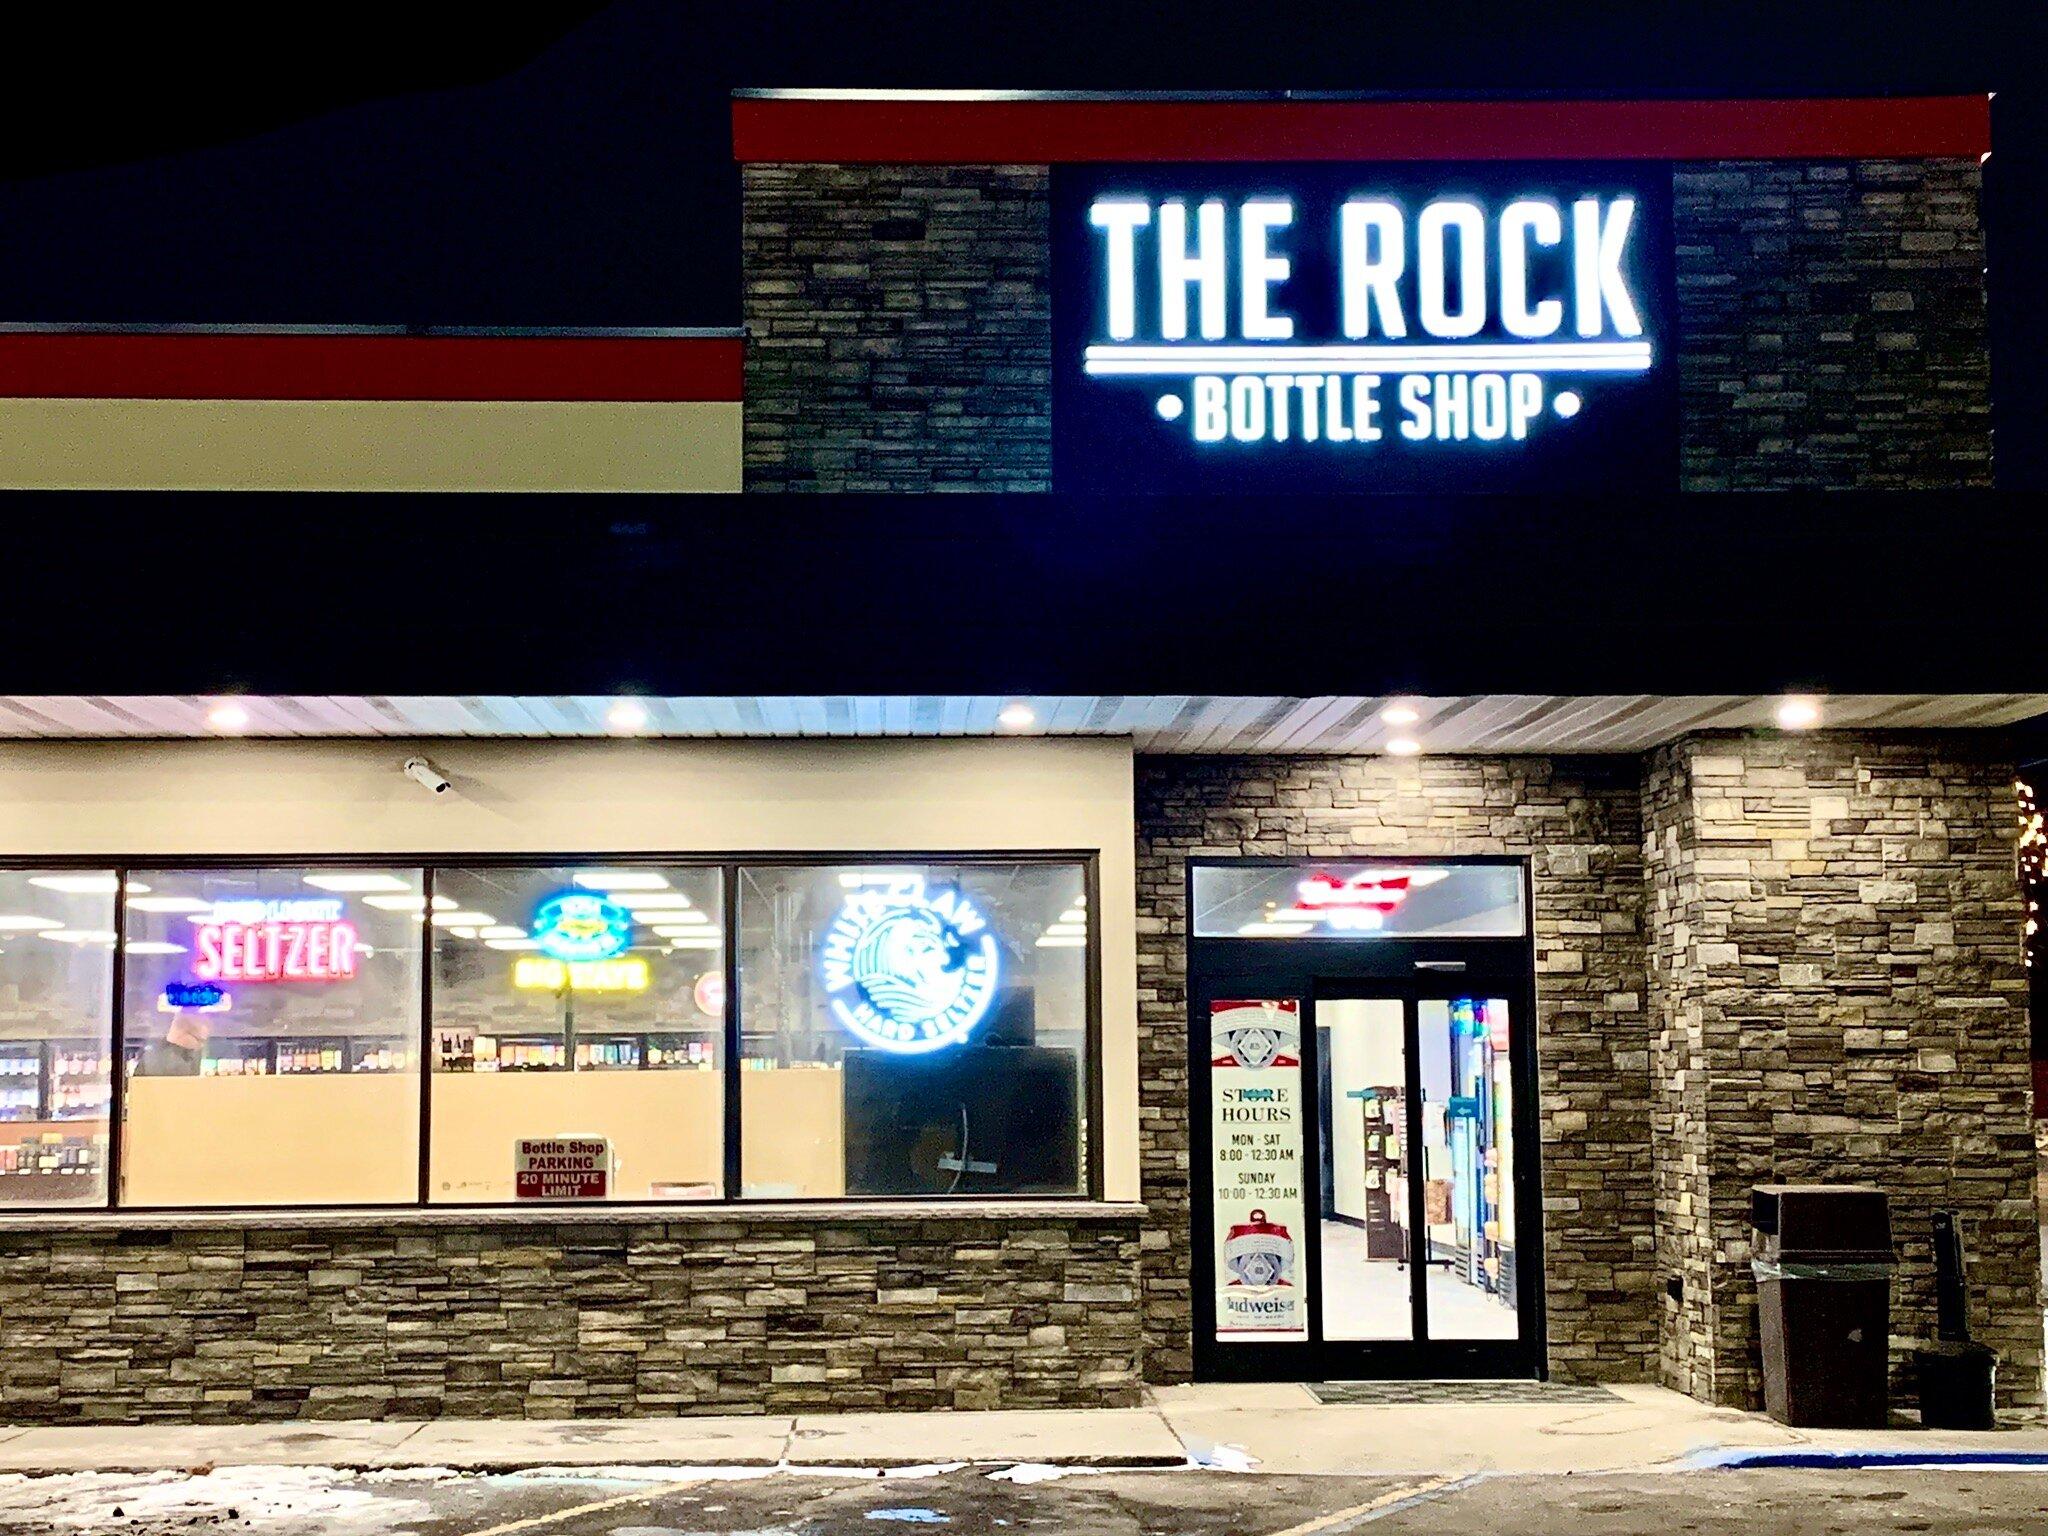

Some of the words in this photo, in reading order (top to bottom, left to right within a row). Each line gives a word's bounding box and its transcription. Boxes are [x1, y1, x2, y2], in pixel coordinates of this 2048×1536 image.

[1091, 201, 1294, 340] THE
[1341, 200, 1643, 339] ROCK
[1193, 375, 1381, 442] BOTTLE
[1400, 374, 1543, 441] SHOP
[197, 923, 353, 978] SELTZER
[1222, 1107, 1291, 1121] HOURS
[1232, 1134, 1254, 1146] MON
[1264, 1134, 1280, 1145] SAT
[522, 1141, 564, 1155] Bottle
[570, 1141, 604, 1156] Shop
[1280, 1149, 1294, 1160] AM
[529, 1157, 594, 1169] PARKING
[521, 1173, 537, 1184] 20
[543, 1172, 599, 1184] MINUTE
[1238, 1172, 1275, 1184] SUNDAY
[541, 1185, 581, 1197] LIMIT
[1283, 1188, 1297, 1199] AM
